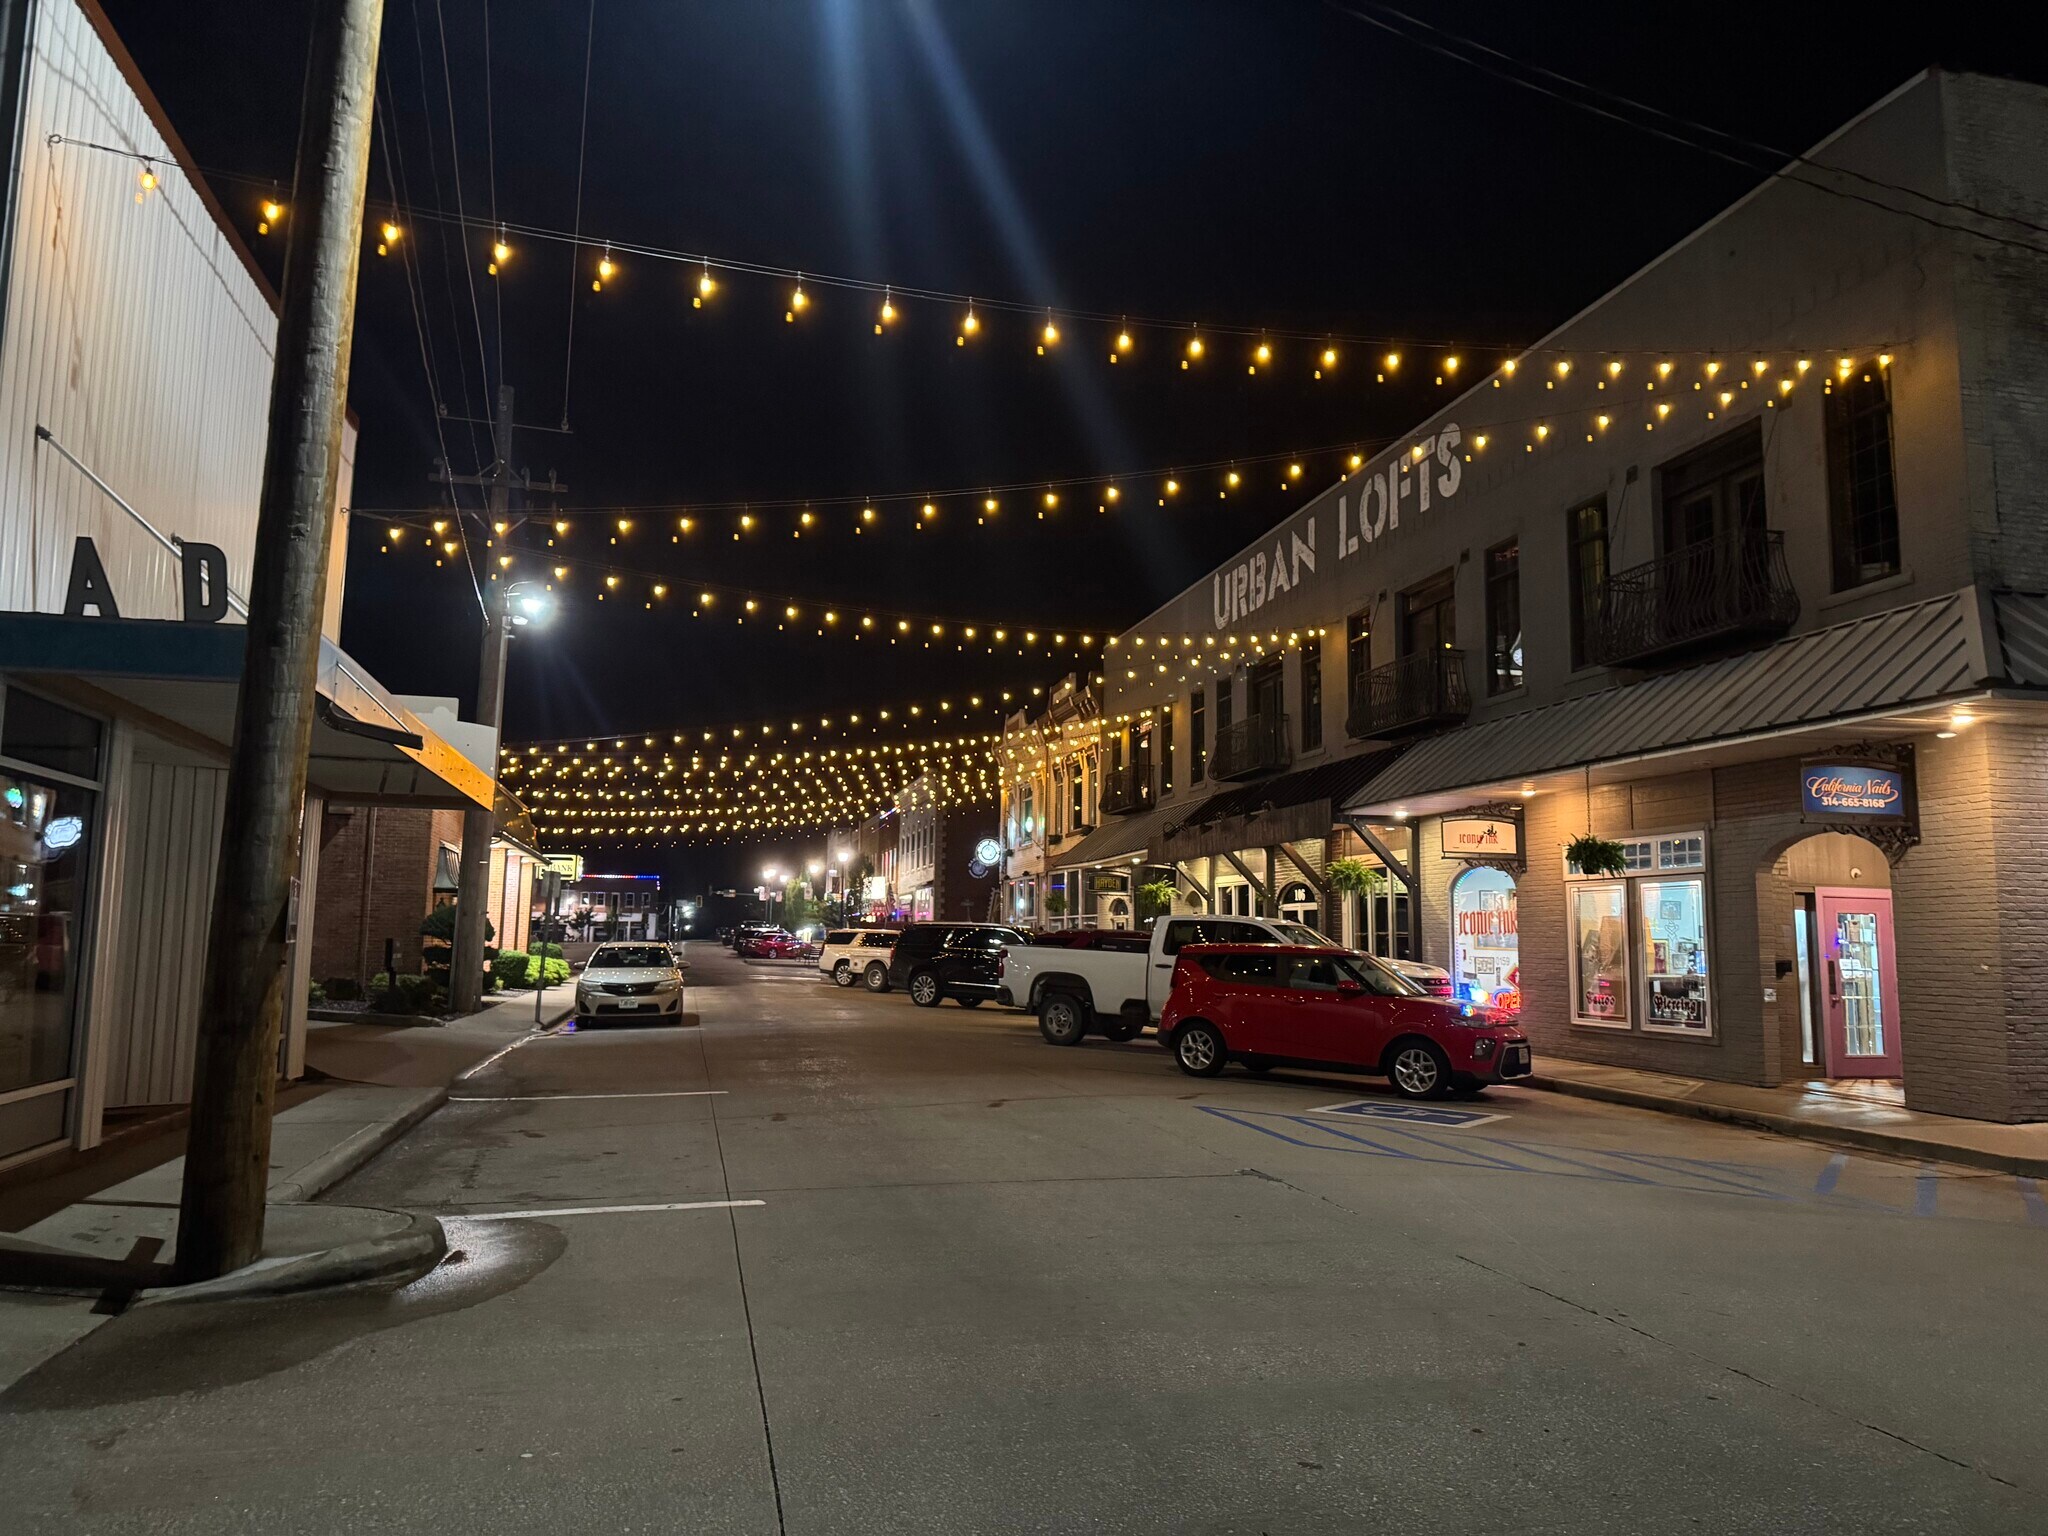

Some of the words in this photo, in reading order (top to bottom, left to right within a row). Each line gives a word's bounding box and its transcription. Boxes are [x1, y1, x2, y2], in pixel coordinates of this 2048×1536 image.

[1213, 516, 1316, 630] URBAN
[1338, 422, 1462, 560] LOFTS
[1806, 776, 1862, 798] California
[1861, 779, 1899, 803] Nails
[1821, 796, 1886, 809] 314-665-8168
[1653, 994, 1698, 1015] Piercing
